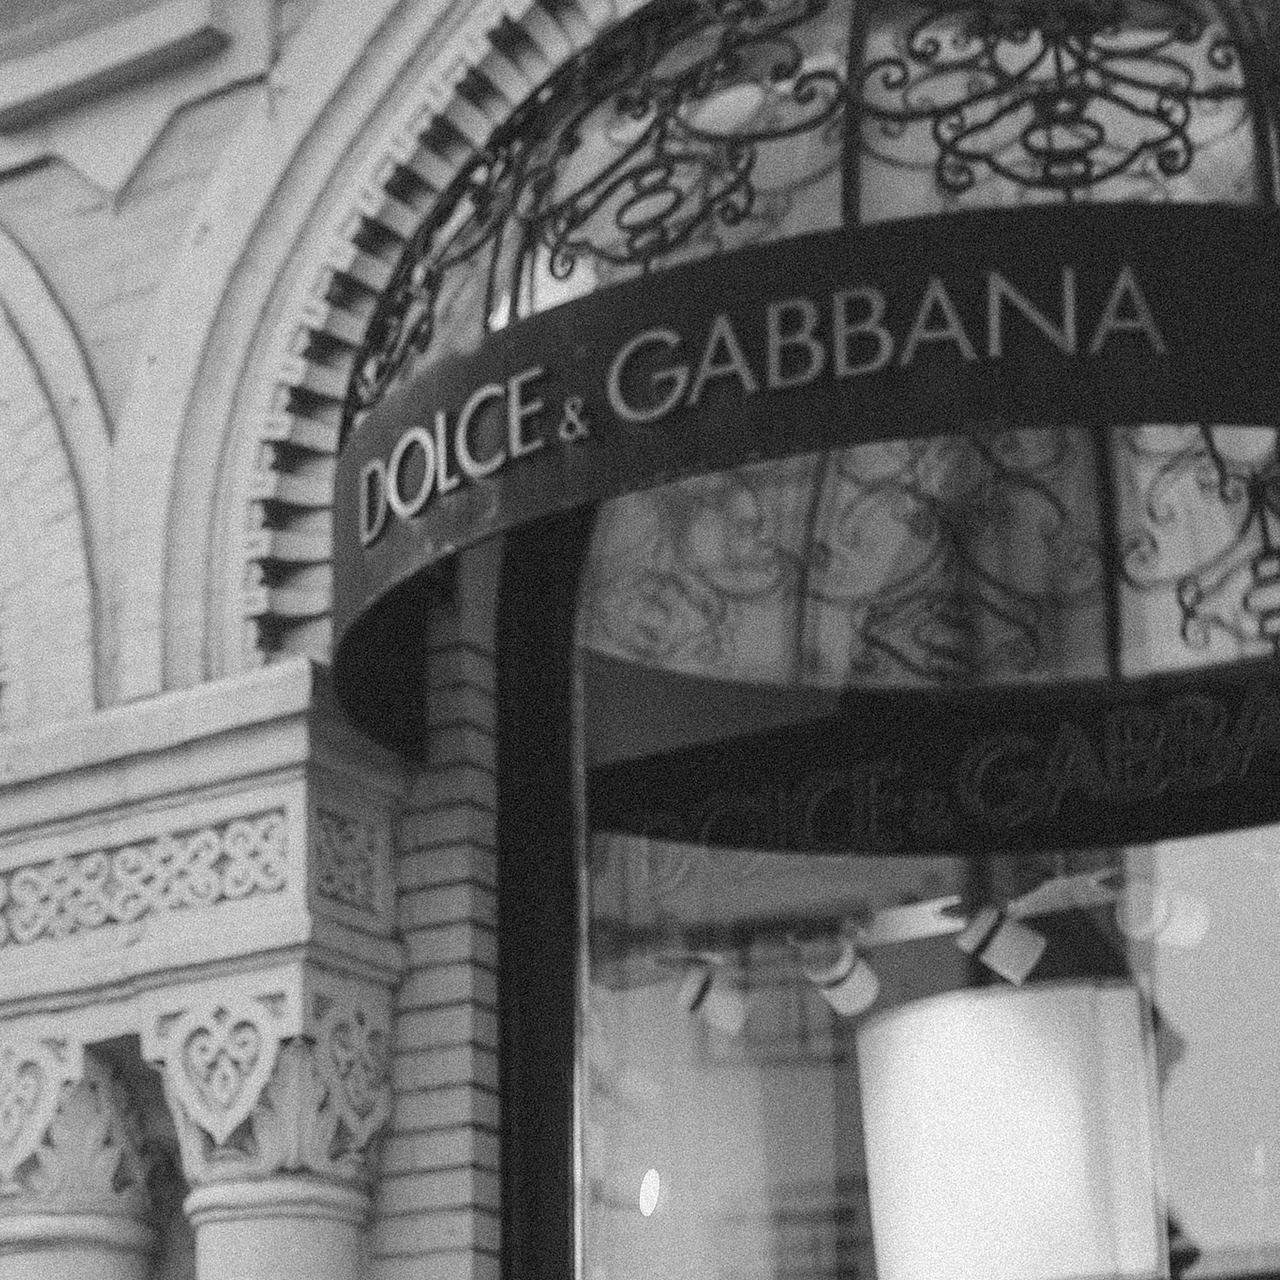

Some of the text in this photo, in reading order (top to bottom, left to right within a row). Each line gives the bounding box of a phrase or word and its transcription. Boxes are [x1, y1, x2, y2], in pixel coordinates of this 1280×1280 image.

[358, 264, 1168, 546] DOLCE & GABBANA
